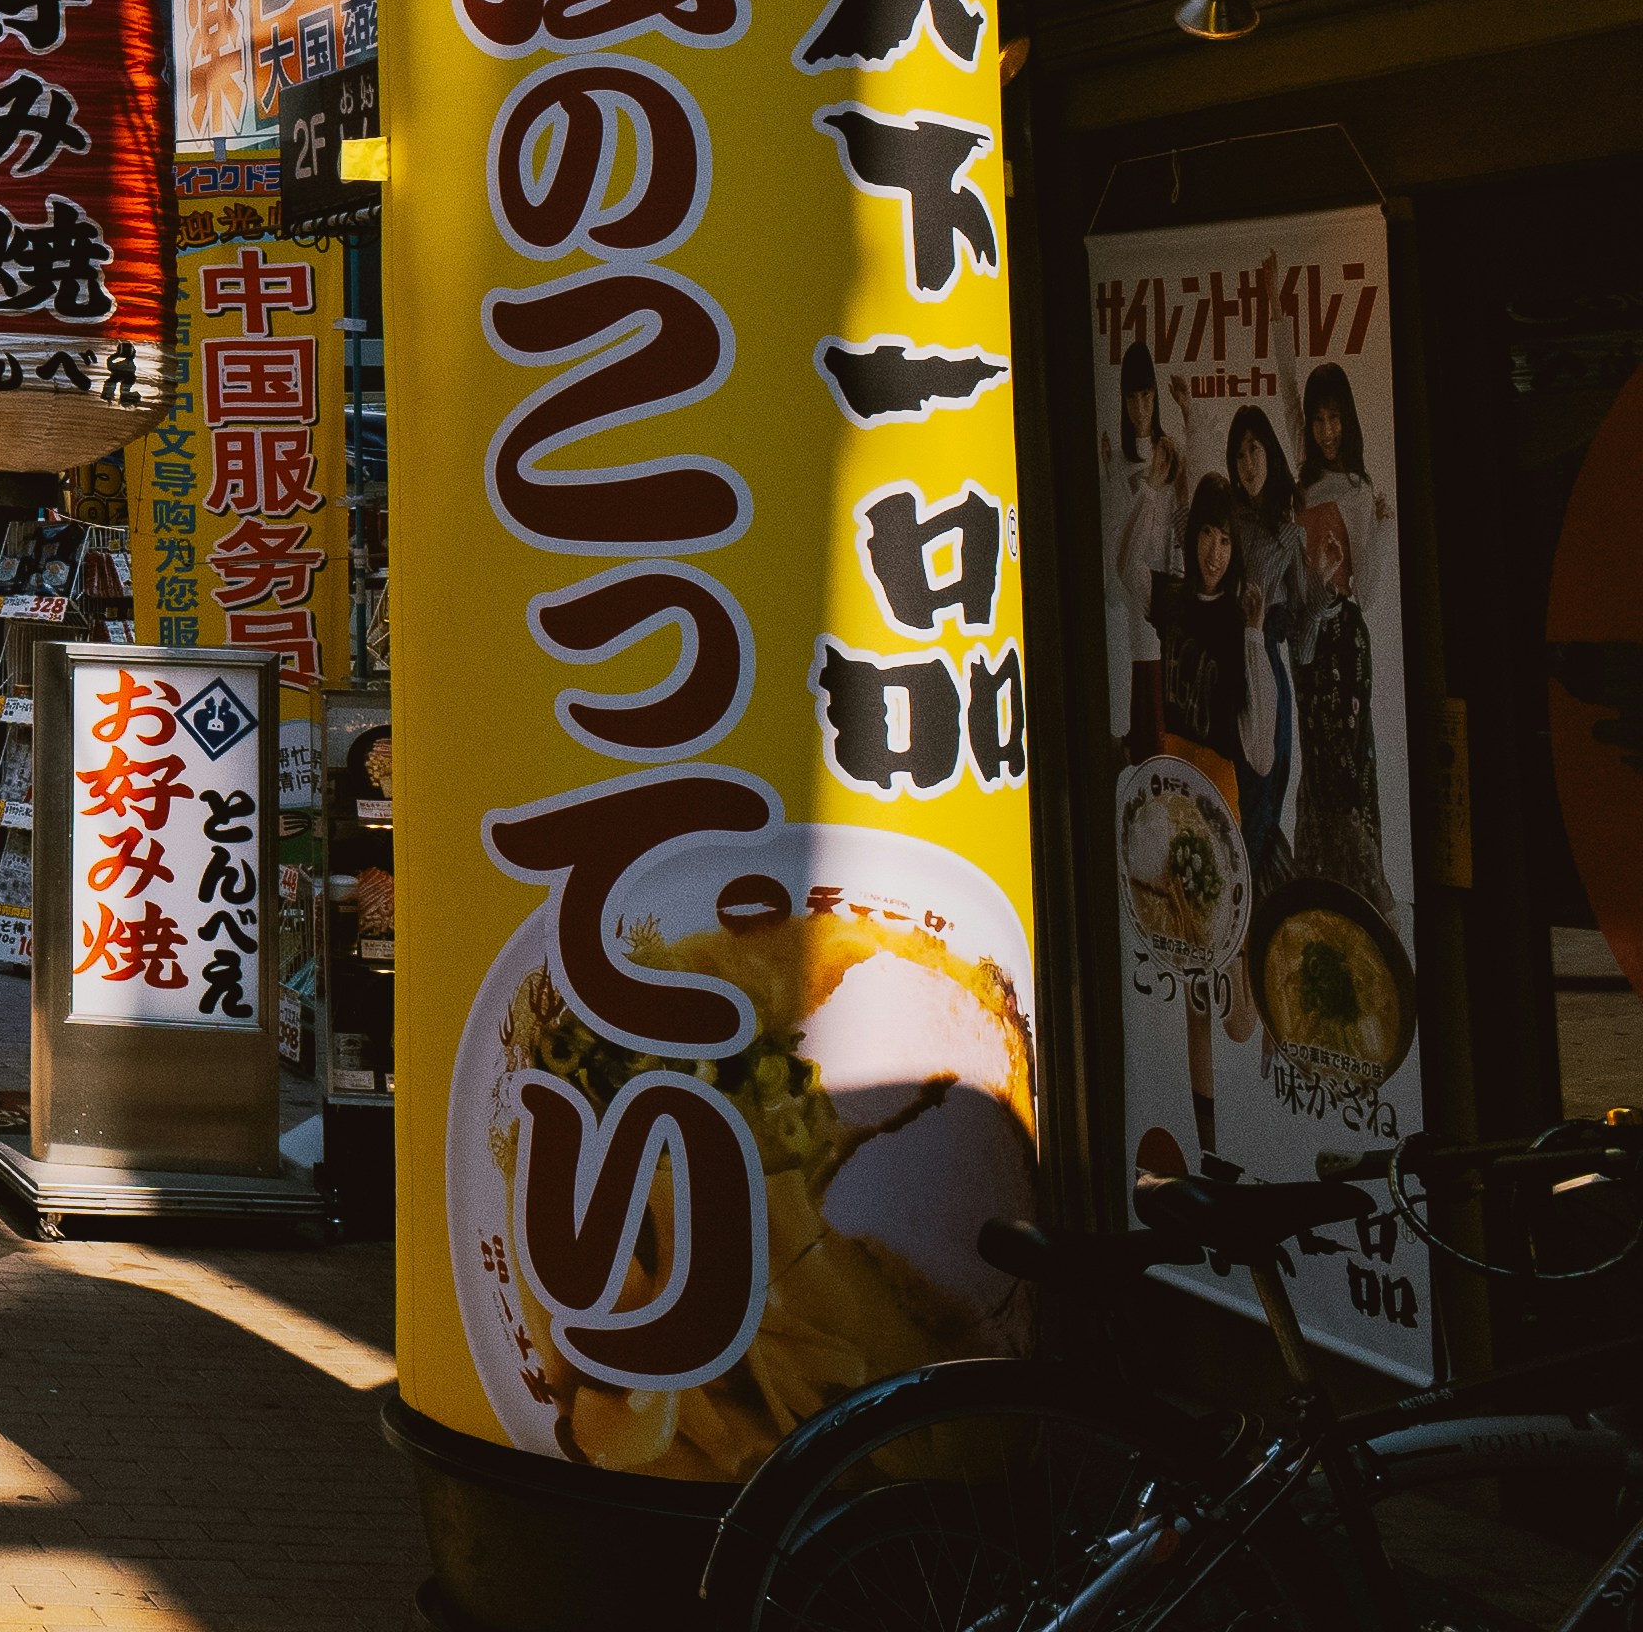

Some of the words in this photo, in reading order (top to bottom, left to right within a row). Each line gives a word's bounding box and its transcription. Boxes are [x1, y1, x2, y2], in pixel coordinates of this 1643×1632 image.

[293, 112, 327, 180] 2F
[1097, 262, 1378, 366] サイレントサイレン
[1191, 366, 1278, 399] with
[199, 245, 324, 691] 中国服务员
[29, 596, 65, 614] 328
[73, 669, 195, 993] お好み焼
[197, 789, 259, 1019] とんべえ
[1133, 951, 1234, 1018] こってり
[1274, 1063, 1400, 1140] 味がさね
